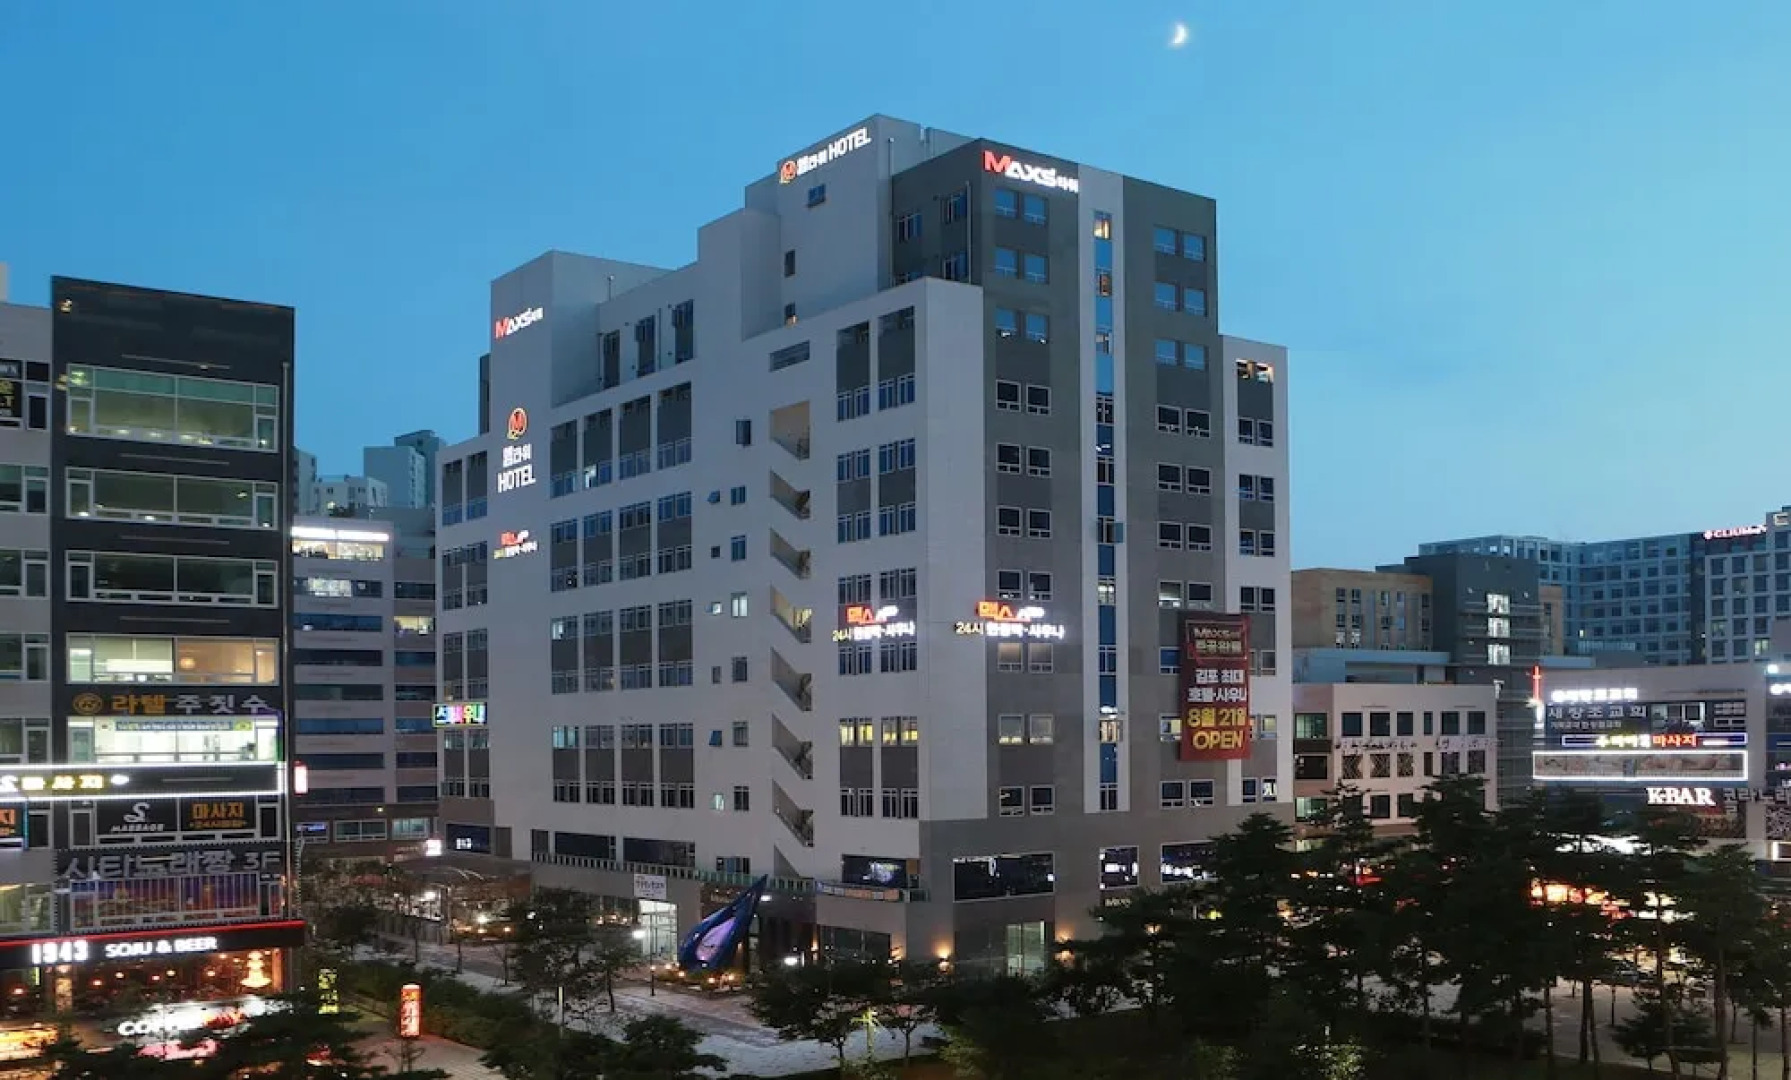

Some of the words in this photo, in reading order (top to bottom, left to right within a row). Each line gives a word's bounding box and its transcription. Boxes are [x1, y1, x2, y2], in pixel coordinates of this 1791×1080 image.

[828, 126, 872, 162] HOTEL
[497, 463, 536, 493] HOTEL
[175, 694, 271, 714] 주짓수
[1188, 707, 1215, 728] 8월
[1192, 730, 1243, 750] OPEN
[1652, 734, 1698, 748] 마사지
[192, 803, 244, 820] 마사지
[243, 851, 282, 870] 3F
[31, 939, 89, 965] 1943
[155, 940, 173, 954] &
[174, 936, 218, 952] BEER
